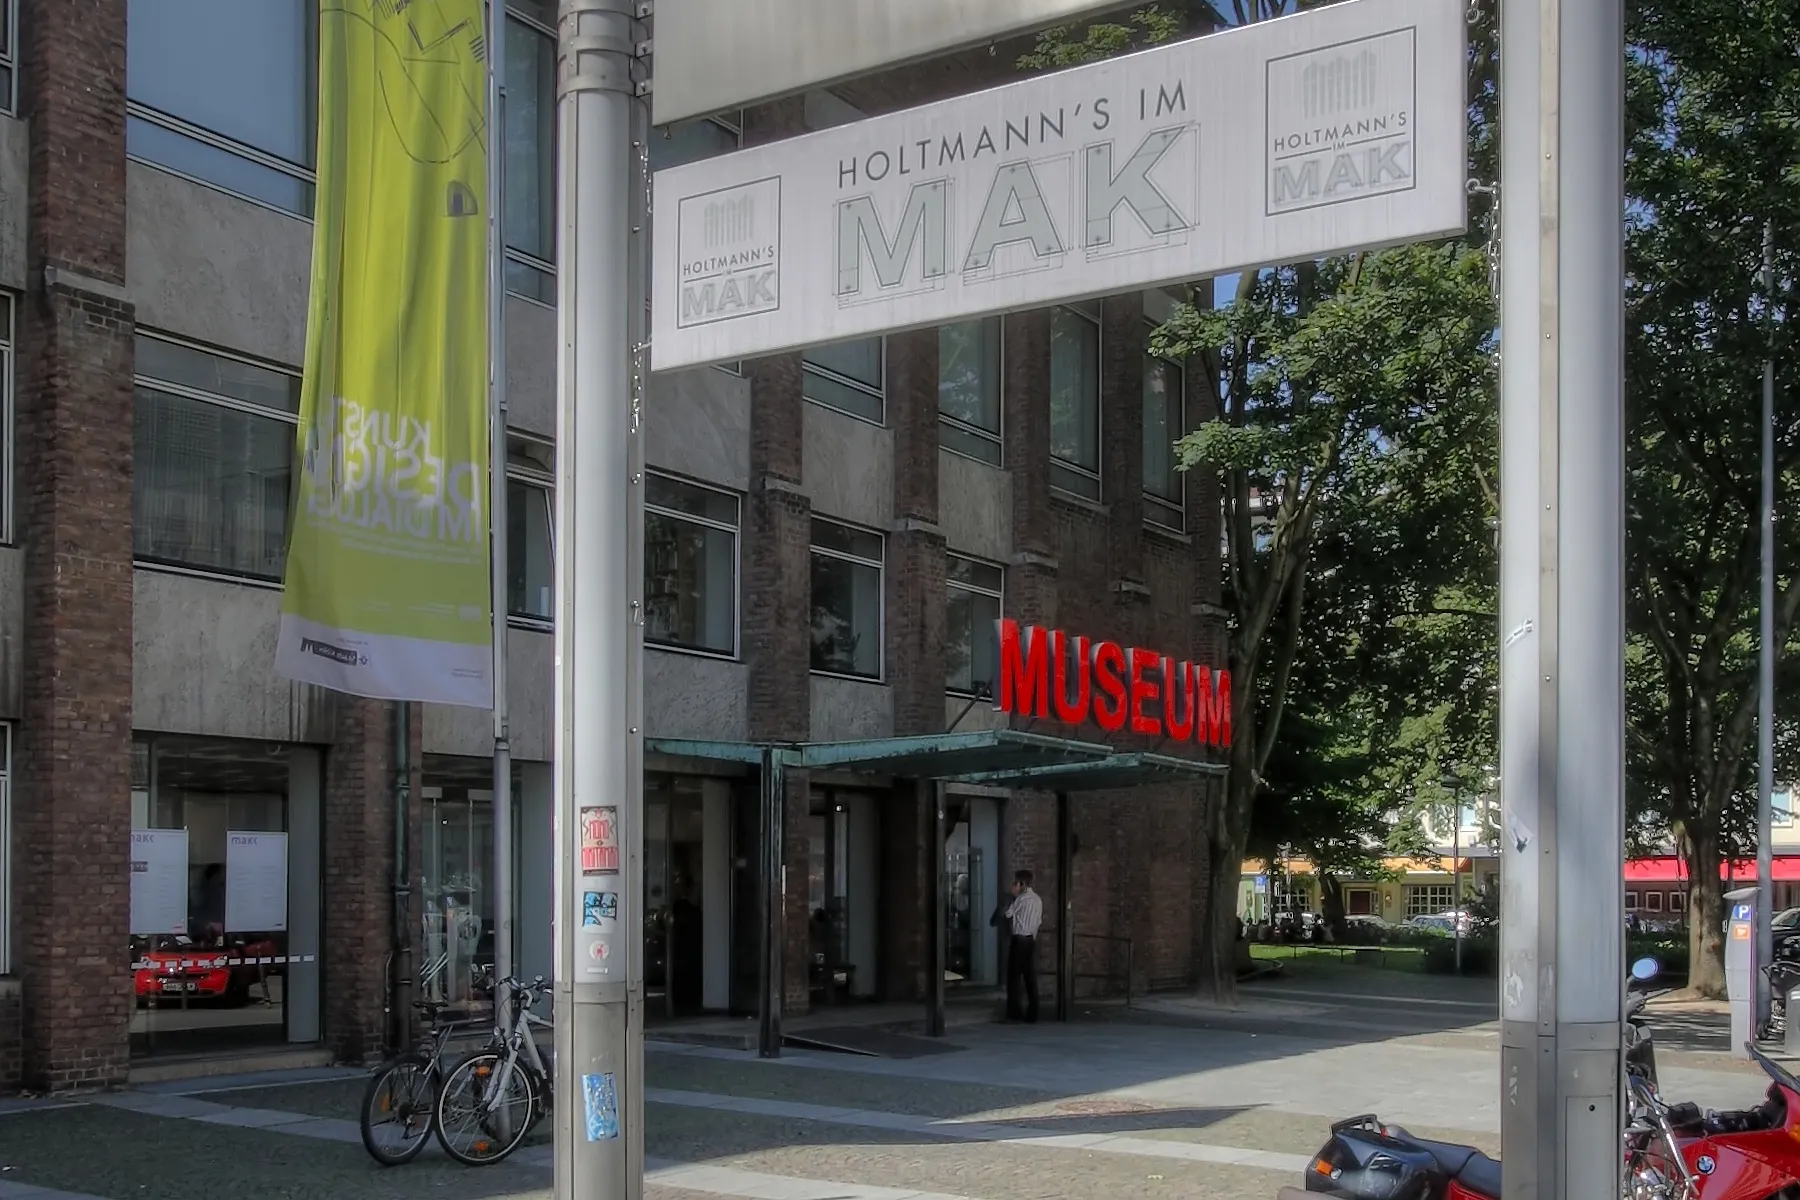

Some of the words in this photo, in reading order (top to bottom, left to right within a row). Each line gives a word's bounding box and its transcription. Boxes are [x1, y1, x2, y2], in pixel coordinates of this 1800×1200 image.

[1139, 80, 1187, 121] IM
[1274, 142, 1410, 204] MAK
[834, 122, 1195, 300] MAK
[683, 271, 776, 319] MAK
[993, 619, 1231, 747] MUSEUM
[1738, 904, 1749, 919] P
